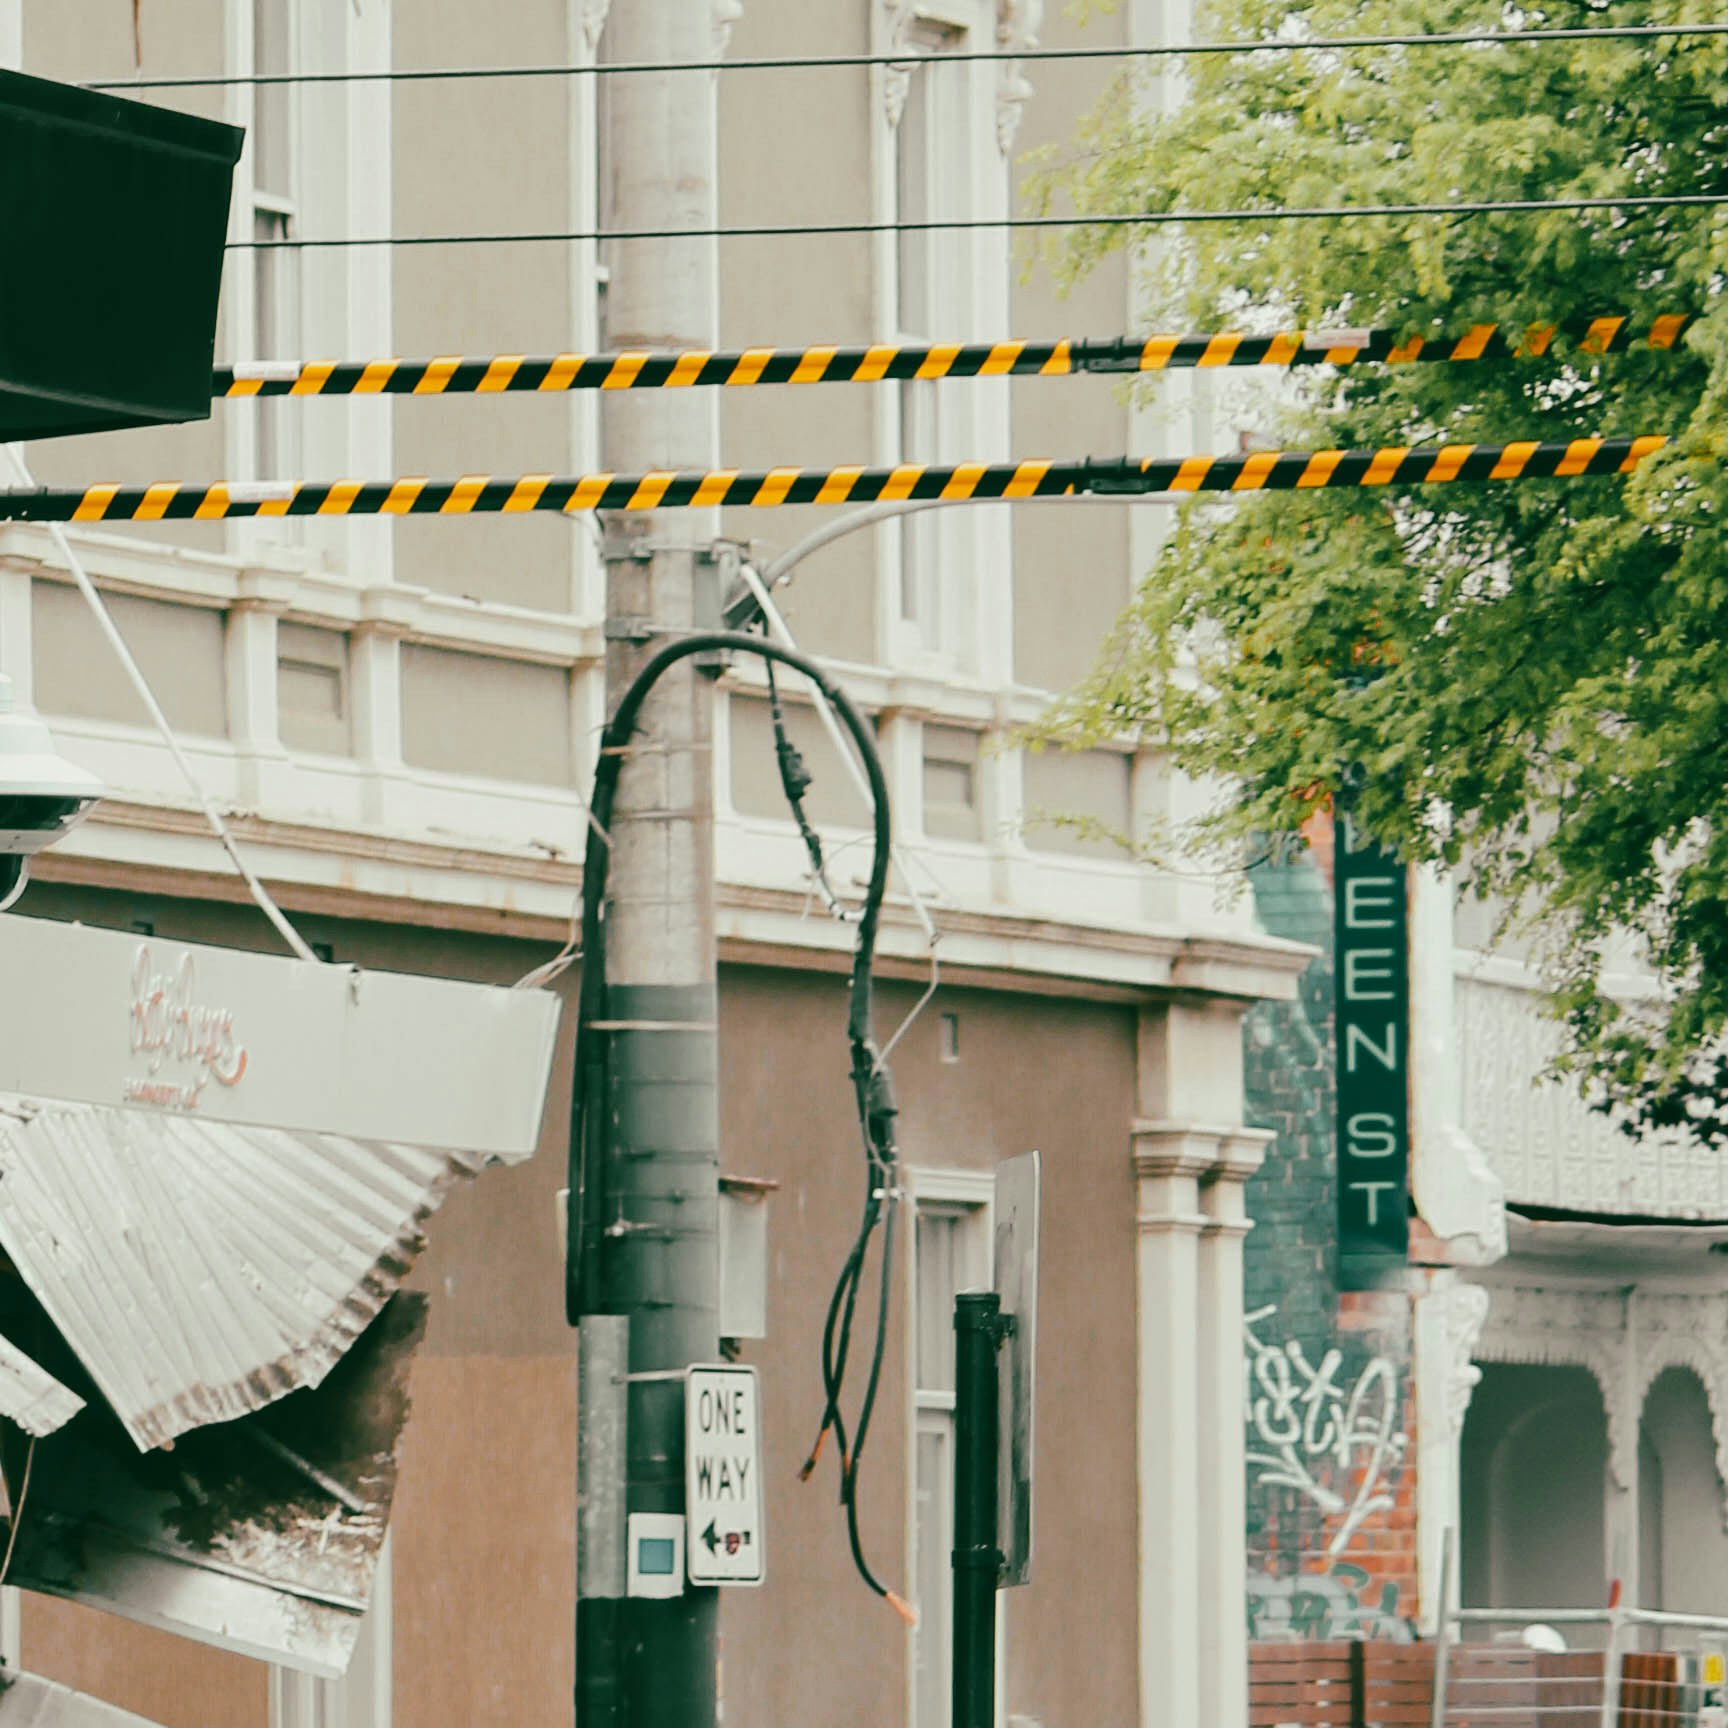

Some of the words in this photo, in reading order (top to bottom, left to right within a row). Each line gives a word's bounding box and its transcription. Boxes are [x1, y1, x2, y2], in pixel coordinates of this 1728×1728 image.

[1346, 1112, 1397, 1226] ST
[699, 1389, 746, 1434] ONE
[696, 1456, 751, 1500] WAY
